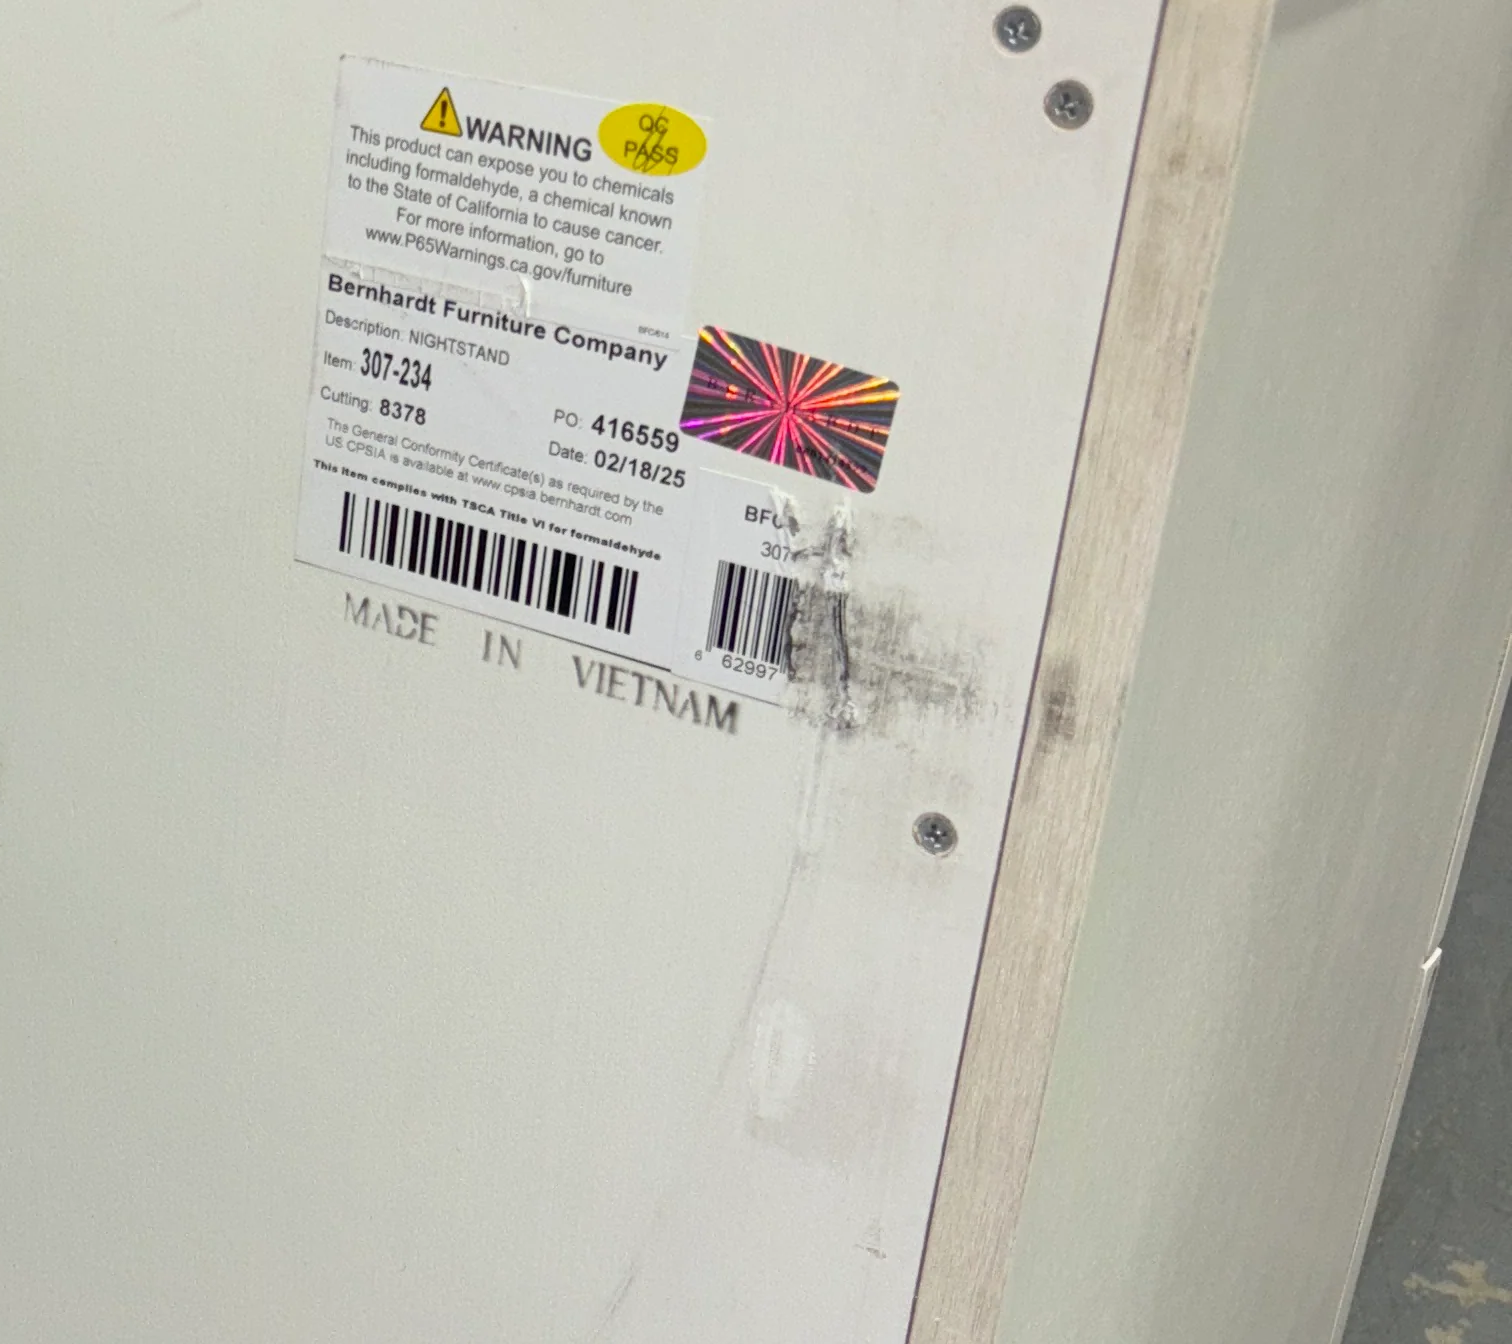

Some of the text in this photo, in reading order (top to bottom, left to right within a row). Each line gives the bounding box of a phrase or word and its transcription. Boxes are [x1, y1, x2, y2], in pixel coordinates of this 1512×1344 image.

[466, 116, 592, 162] WARNING
[639, 114, 669, 135] QC
[350, 124, 674, 205] This product can expose you to chemicals
[624, 140, 679, 165] PASS
[346, 148, 672, 230] including formaldehyde, a chemical known
[348, 174, 664, 254] to the State of California to cause cancer.
[396, 206, 605, 266] For more information, go to
[365, 227, 633, 297] www.P65Warnings.ca.gov/furniture
[328, 273, 668, 372] Bernhardt Furniture Company
[323, 347, 432, 391] Item: 307-234
[408, 330, 510, 366] NIGHTSTAND
[320, 385, 426, 425] Cutting: 8378
[553, 408, 679, 453] PO: 416559
[325, 434, 343, 449] US
[346, 440, 386, 460] CPSIA
[389, 453, 399, 464] is
[402, 456, 453, 479] available
[457, 470, 468, 483] at
[327, 417, 664, 516] The General Conformity Certificate(s) as required by the
[548, 440, 686, 488] Date: 02/18/25
[313, 458, 338, 473] This
[372, 475, 427, 497] complies
[430, 492, 457, 506] with
[462, 499, 495, 516] TSCA
[499, 508, 528, 524] Title
[532, 517, 545, 530] VI
[548, 523, 567, 536] for
[570, 528, 662, 561] formaldehyde
[344, 592, 740, 735] MADE IN VIETNAM
[694, 650, 779, 681] 6 62997
